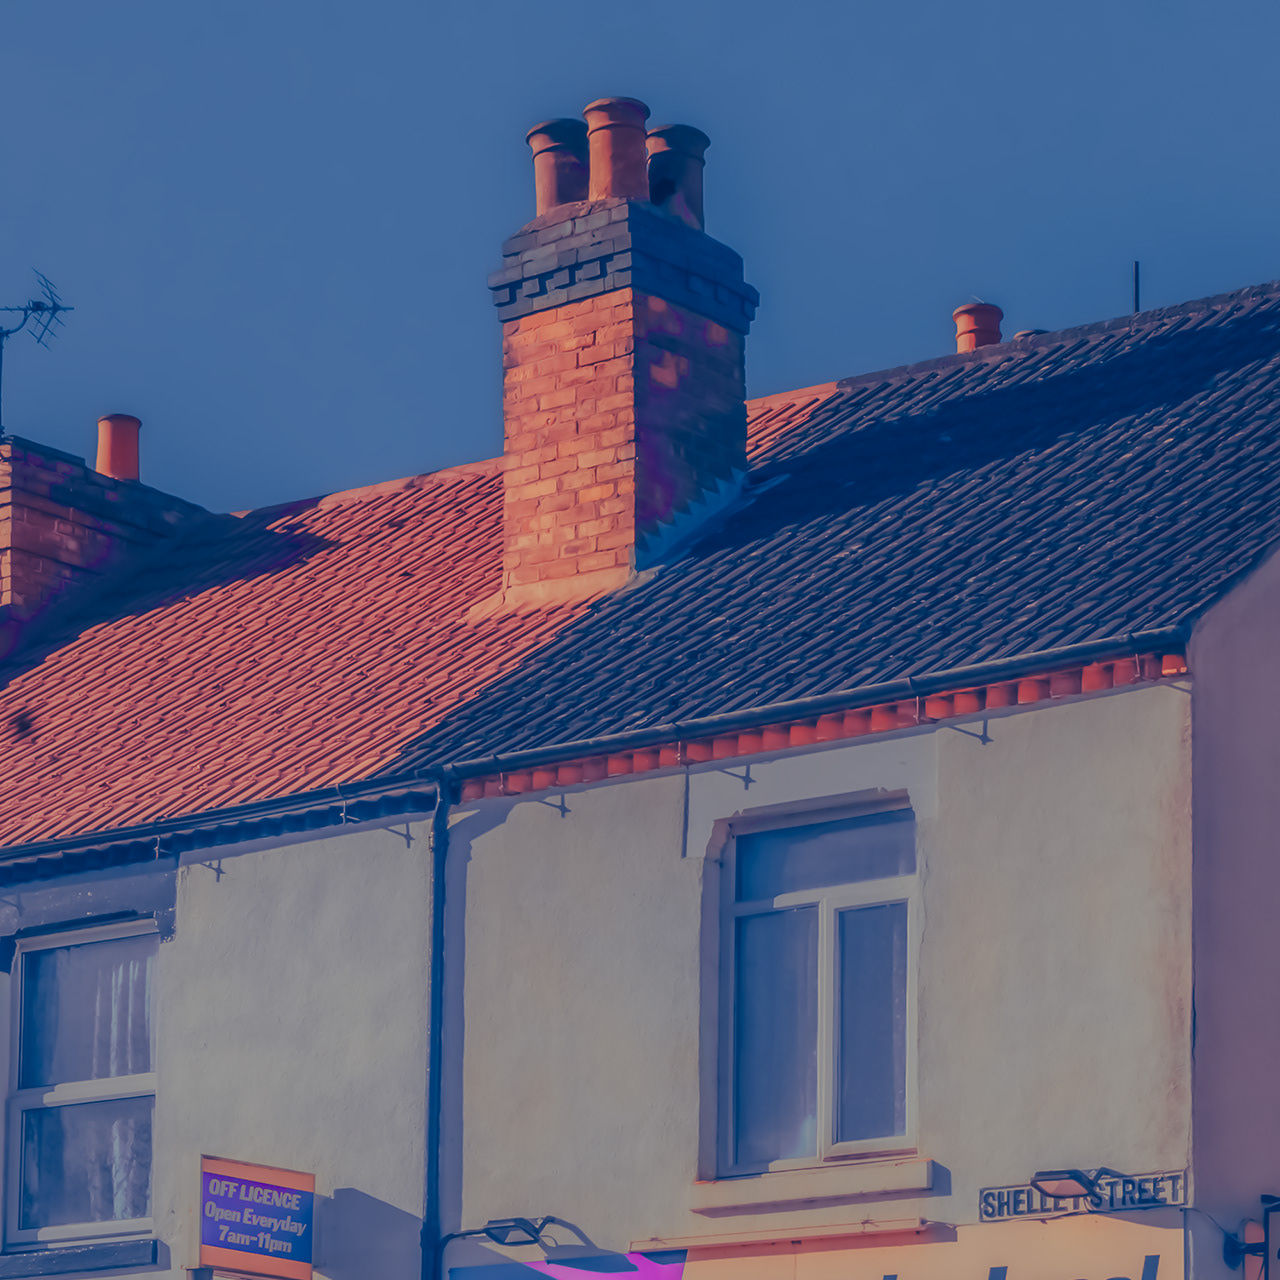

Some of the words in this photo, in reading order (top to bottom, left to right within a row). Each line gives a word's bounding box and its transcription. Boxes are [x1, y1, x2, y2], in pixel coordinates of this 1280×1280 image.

[209, 1178, 238, 1198] OFF
[239, 1184, 301, 1210] LICENCE
[1089, 1175, 1182, 1209] STREET
[205, 1201, 241, 1222] Open
[243, 1208, 307, 1236] Everyday
[219, 1224, 292, 1253] 7am-11pm
